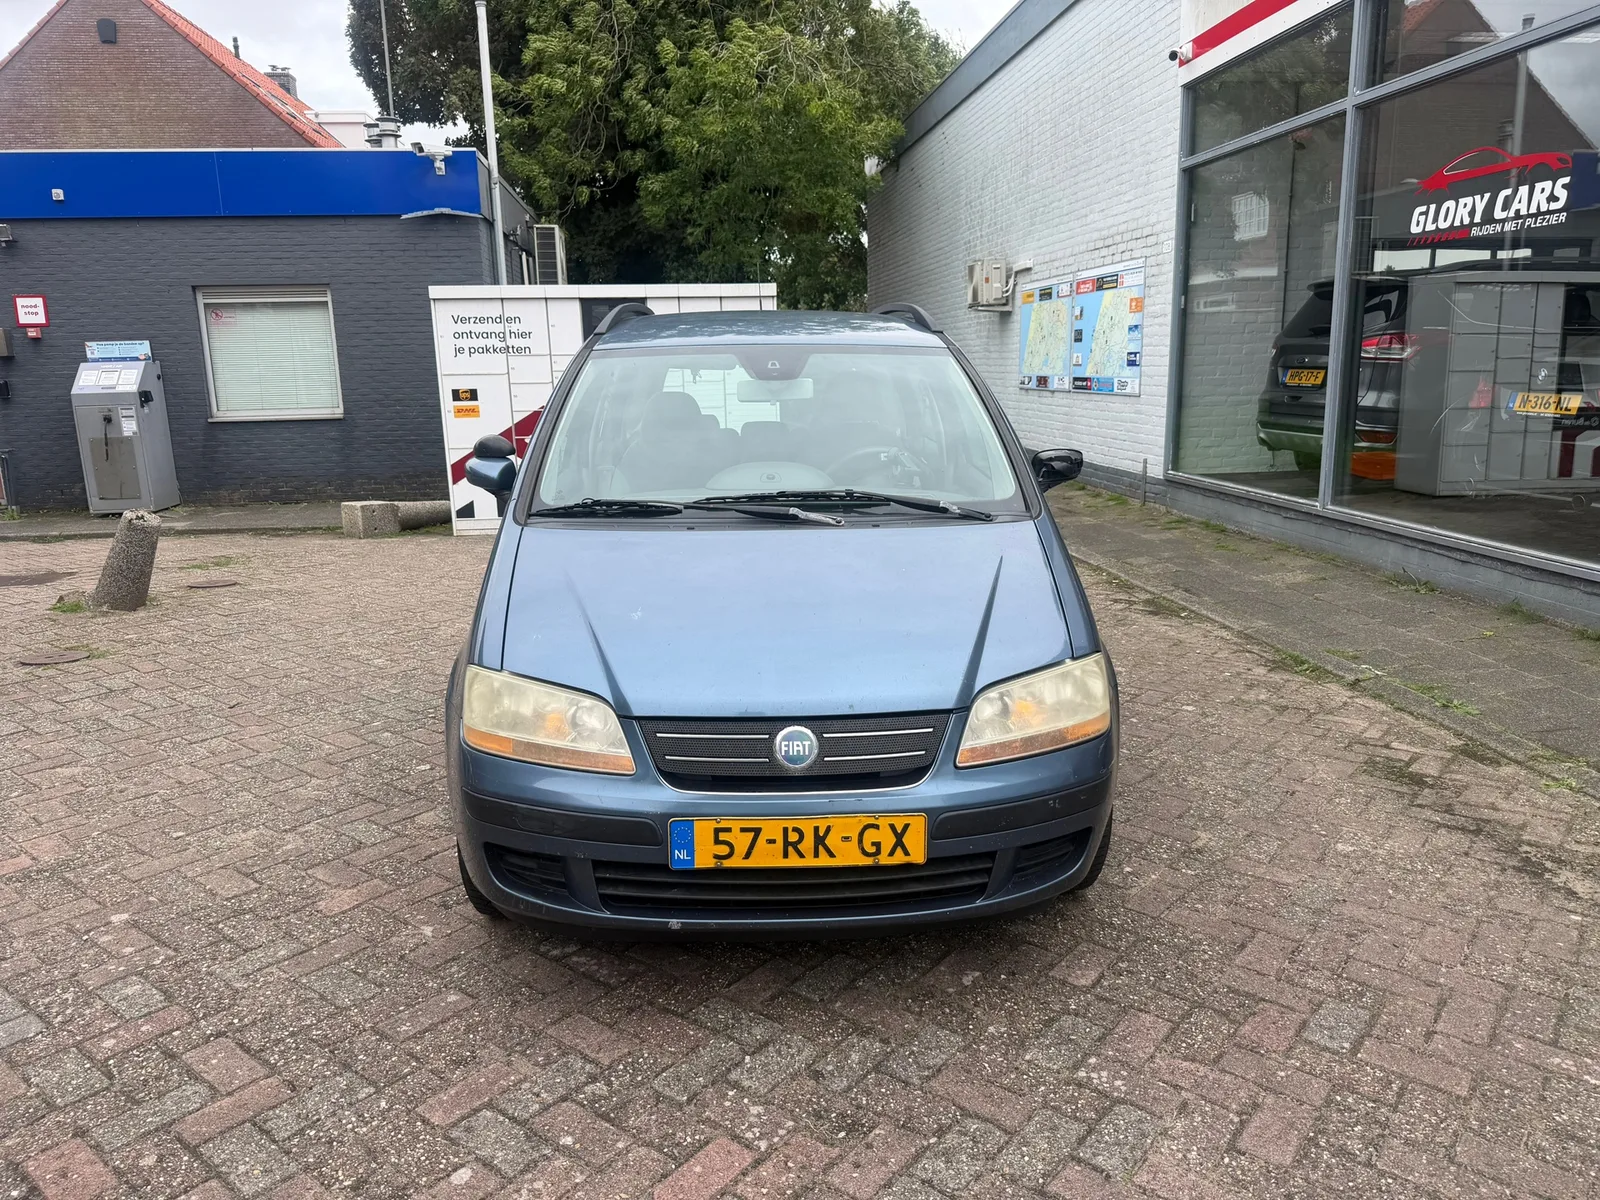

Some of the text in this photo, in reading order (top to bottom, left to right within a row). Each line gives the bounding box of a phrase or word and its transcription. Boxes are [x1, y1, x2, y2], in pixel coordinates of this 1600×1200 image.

[1410, 176, 1571, 234] GLORY CARS
[1470, 212, 1567, 237] RIJDEN MET PLEZIER
[451, 314, 521, 325] Verzend en
[452, 329, 533, 342] ontvang hier
[453, 344, 532, 357] je pakketten
[1288, 371, 1321, 382] HPG-17-F
[1518, 394, 1572, 412] N-316-NL
[781, 740, 811, 756] FIAT
[712, 822, 911, 861] 57-RK-GX
[674, 849, 691, 861] NL
